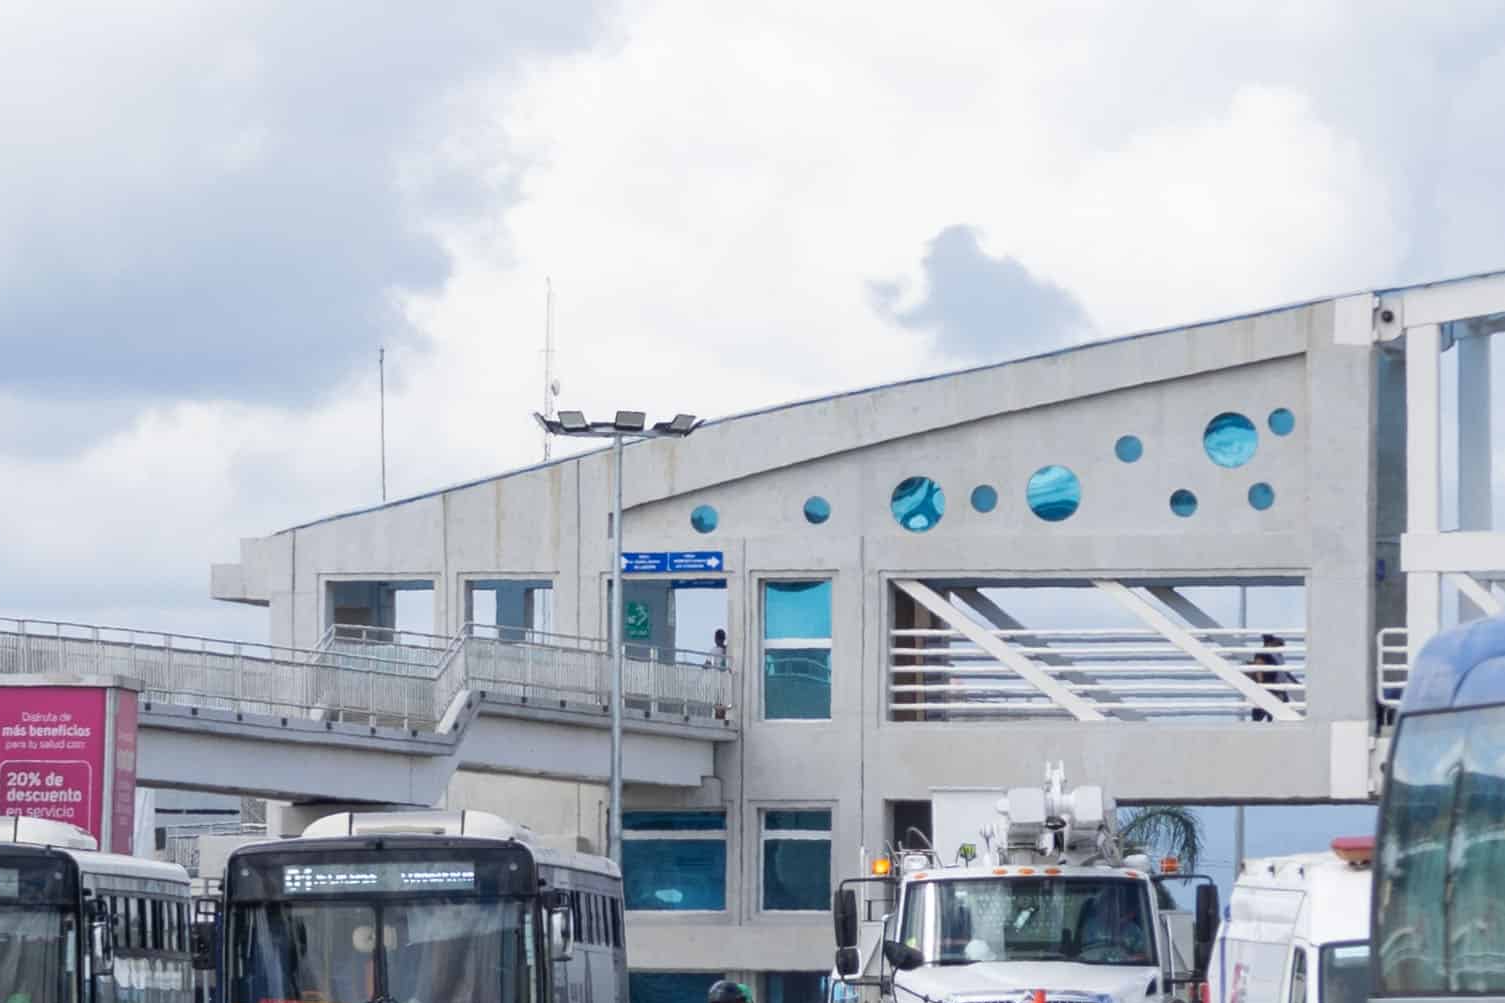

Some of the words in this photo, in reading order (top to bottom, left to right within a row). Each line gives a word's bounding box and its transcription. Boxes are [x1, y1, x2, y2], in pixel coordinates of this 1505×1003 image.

[22, 711, 57, 722] Disfruta
[59, 711, 72, 722] de
[1, 725, 27, 737] más
[29, 724, 91, 737] beneficios
[6, 772, 41, 787] 20%
[45, 772, 64, 787] de
[6, 787, 82, 803] descuento
[6, 807, 23, 817] en
[26, 805, 75, 818] servicio
